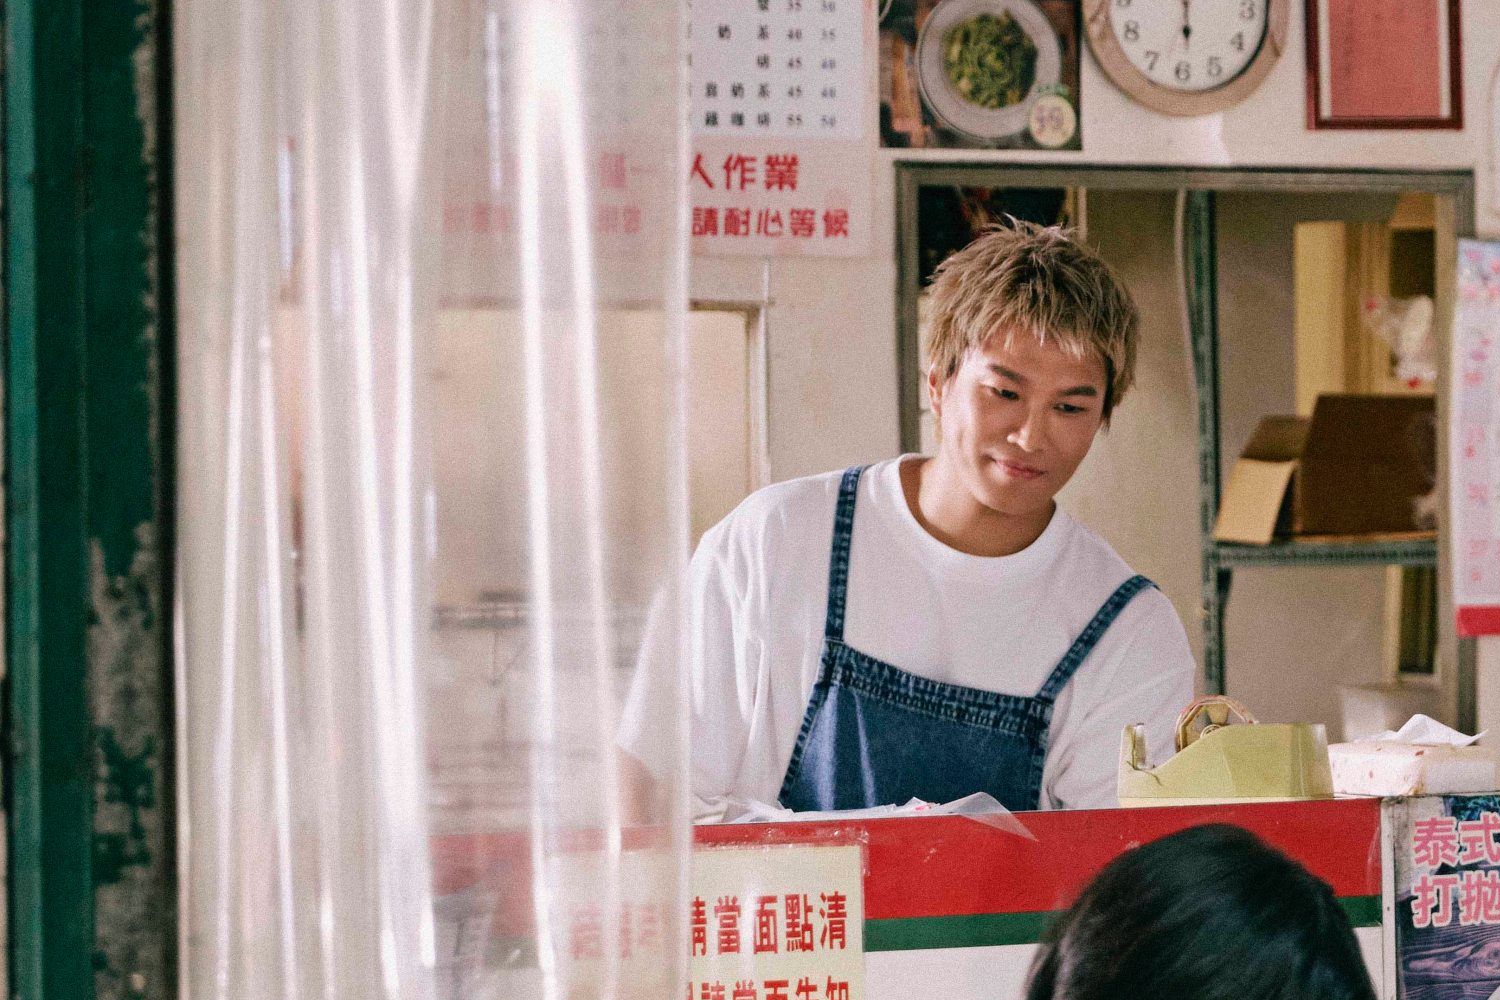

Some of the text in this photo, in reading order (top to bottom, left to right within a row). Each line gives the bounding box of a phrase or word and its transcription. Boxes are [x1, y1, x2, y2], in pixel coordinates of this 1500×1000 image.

[1240, 0, 1255, 20] 3
[1124, 19, 1140, 42] 8
[1231, 32, 1245, 52] 4
[1145, 50, 1160, 71] 7
[1207, 56, 1223, 77] 5
[1175, 61, 1191, 82] 6
[691, 206, 850, 238] 請耐心等候
